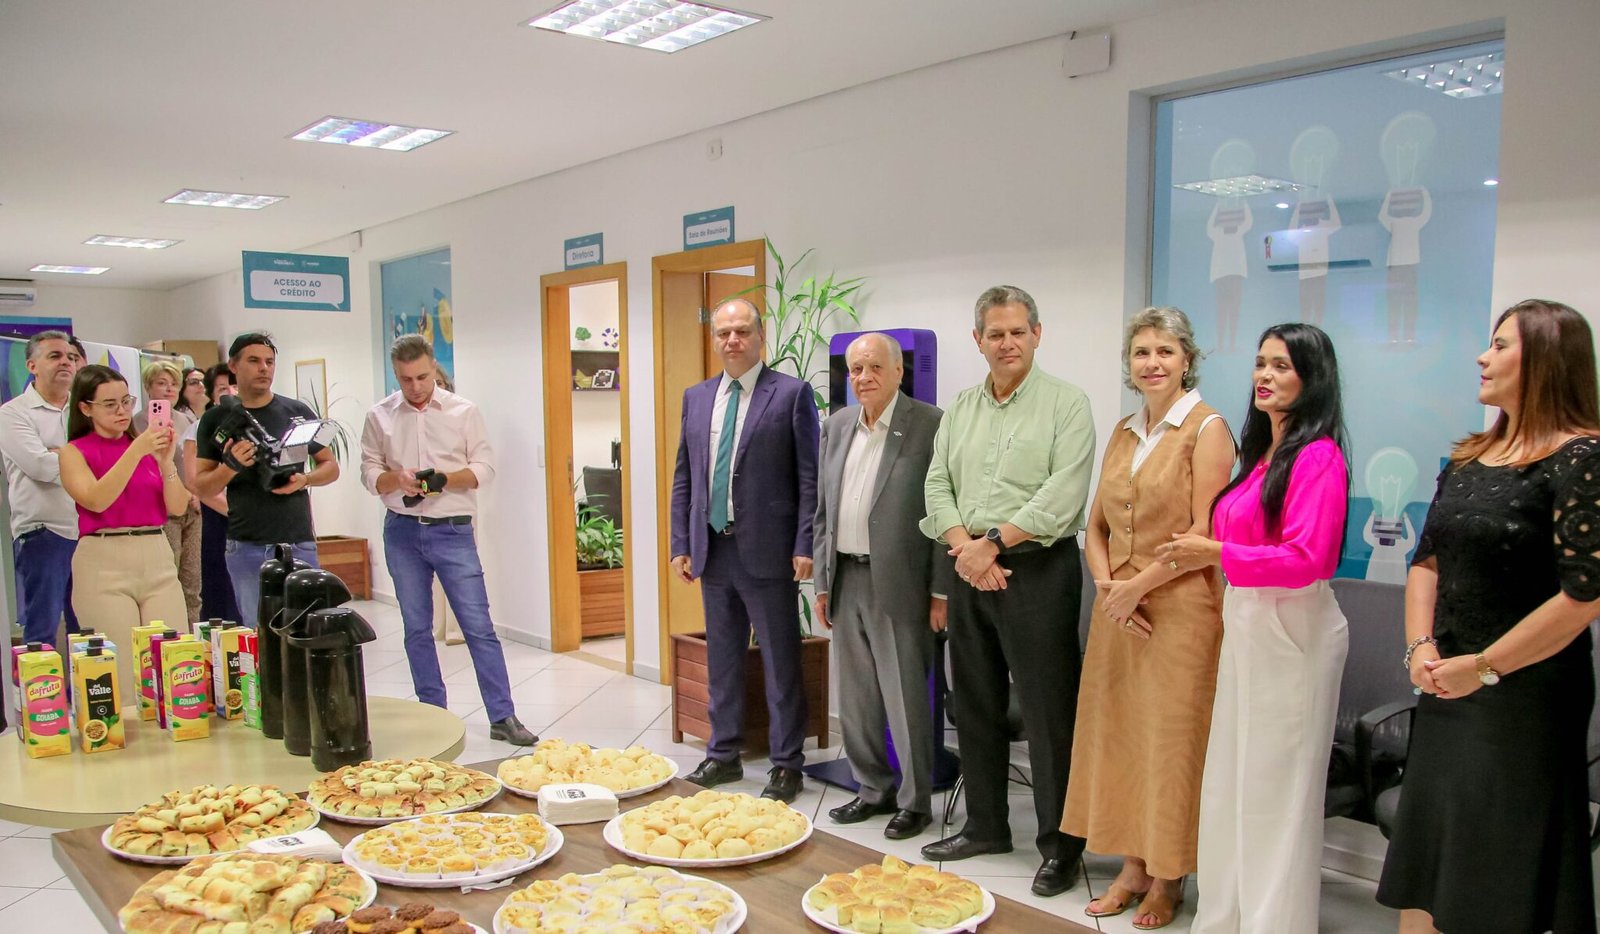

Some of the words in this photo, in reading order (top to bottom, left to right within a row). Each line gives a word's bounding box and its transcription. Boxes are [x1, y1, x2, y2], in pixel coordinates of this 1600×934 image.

[689, 231, 699, 239] Sala
[572, 250, 594, 261] Diretoria
[273, 278, 307, 287] ACESSO
[309, 280, 322, 288] AO
[280, 287, 316, 297] CRÉDITO
[173, 667, 203, 682] dafruta
[29, 682, 60, 697] dafruta
[88, 686, 112, 696] Valle
[178, 696, 201, 706] GOIABA
